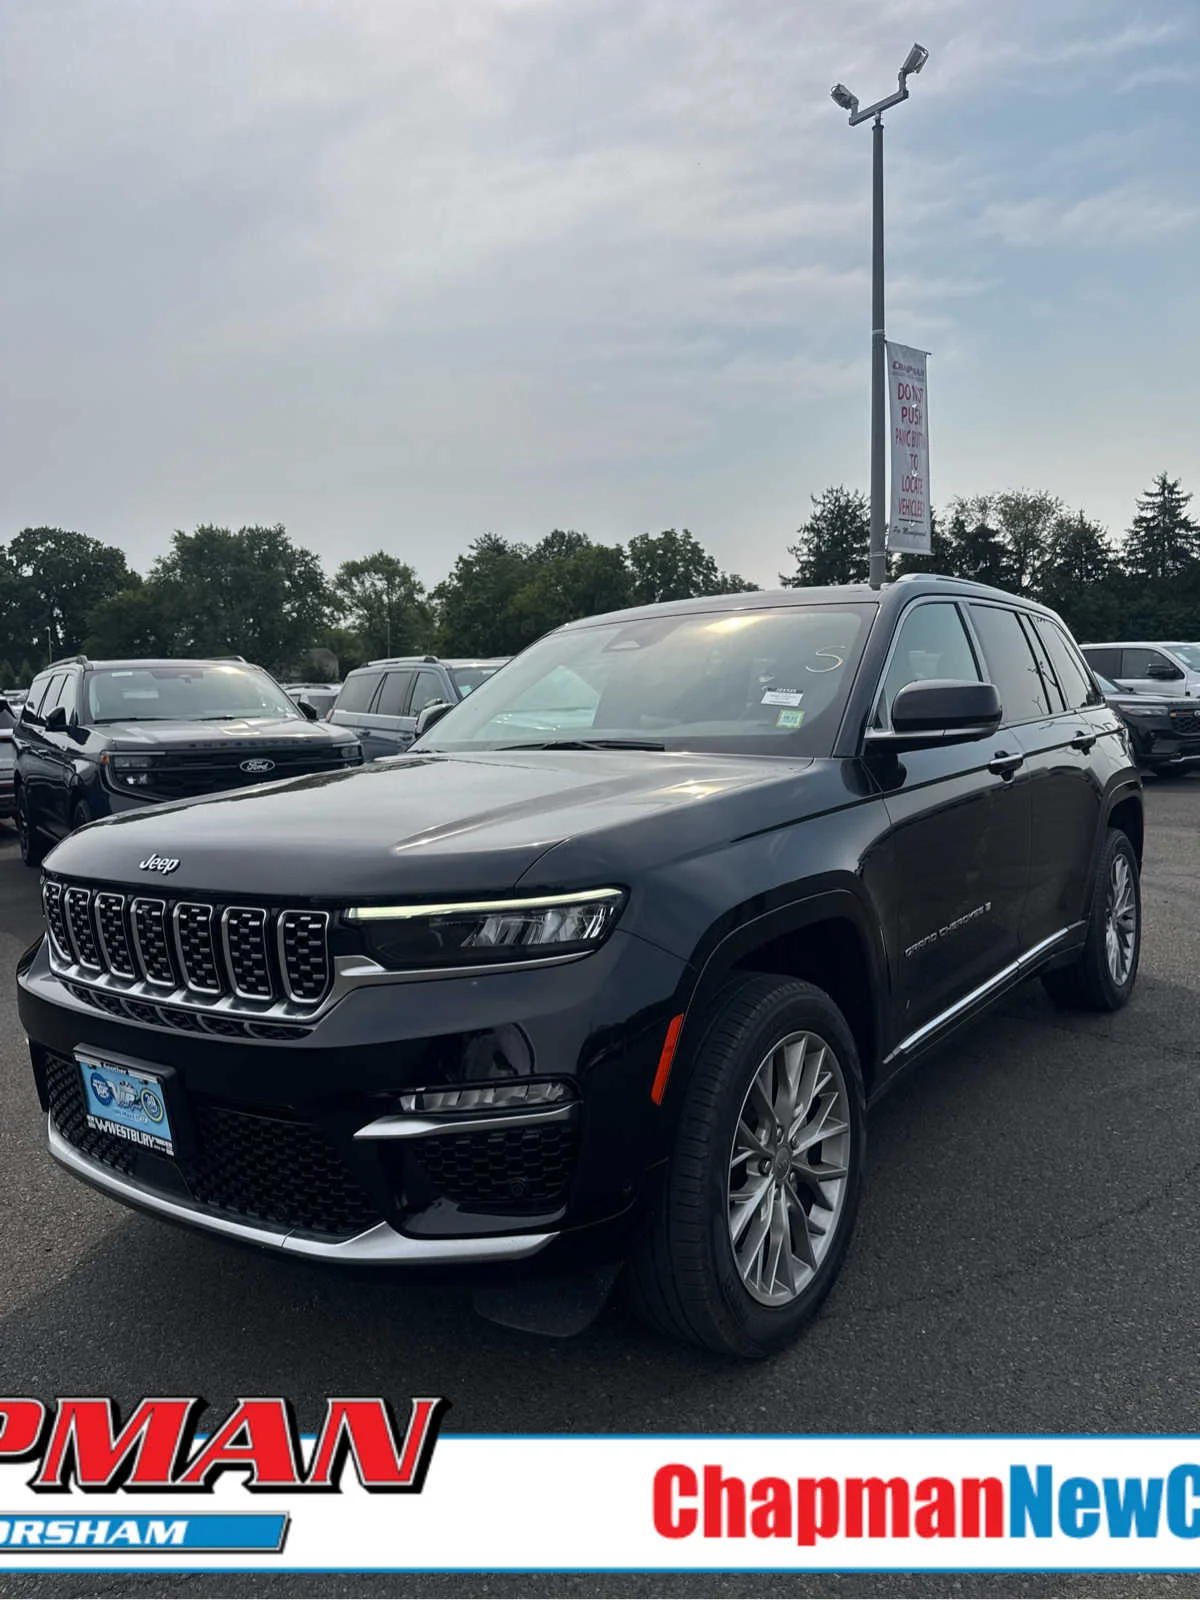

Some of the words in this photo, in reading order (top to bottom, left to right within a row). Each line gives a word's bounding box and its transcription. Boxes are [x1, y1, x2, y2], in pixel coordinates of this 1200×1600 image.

[897, 382, 911, 401] DO
[901, 405, 923, 425] PUSH
[909, 453, 919, 471] TO
[901, 475, 924, 495] LOCATE
[138, 853, 180, 875] Jeep
[904, 931, 938, 958] GRAND
[939, 905, 985, 937] CHEROKEE
